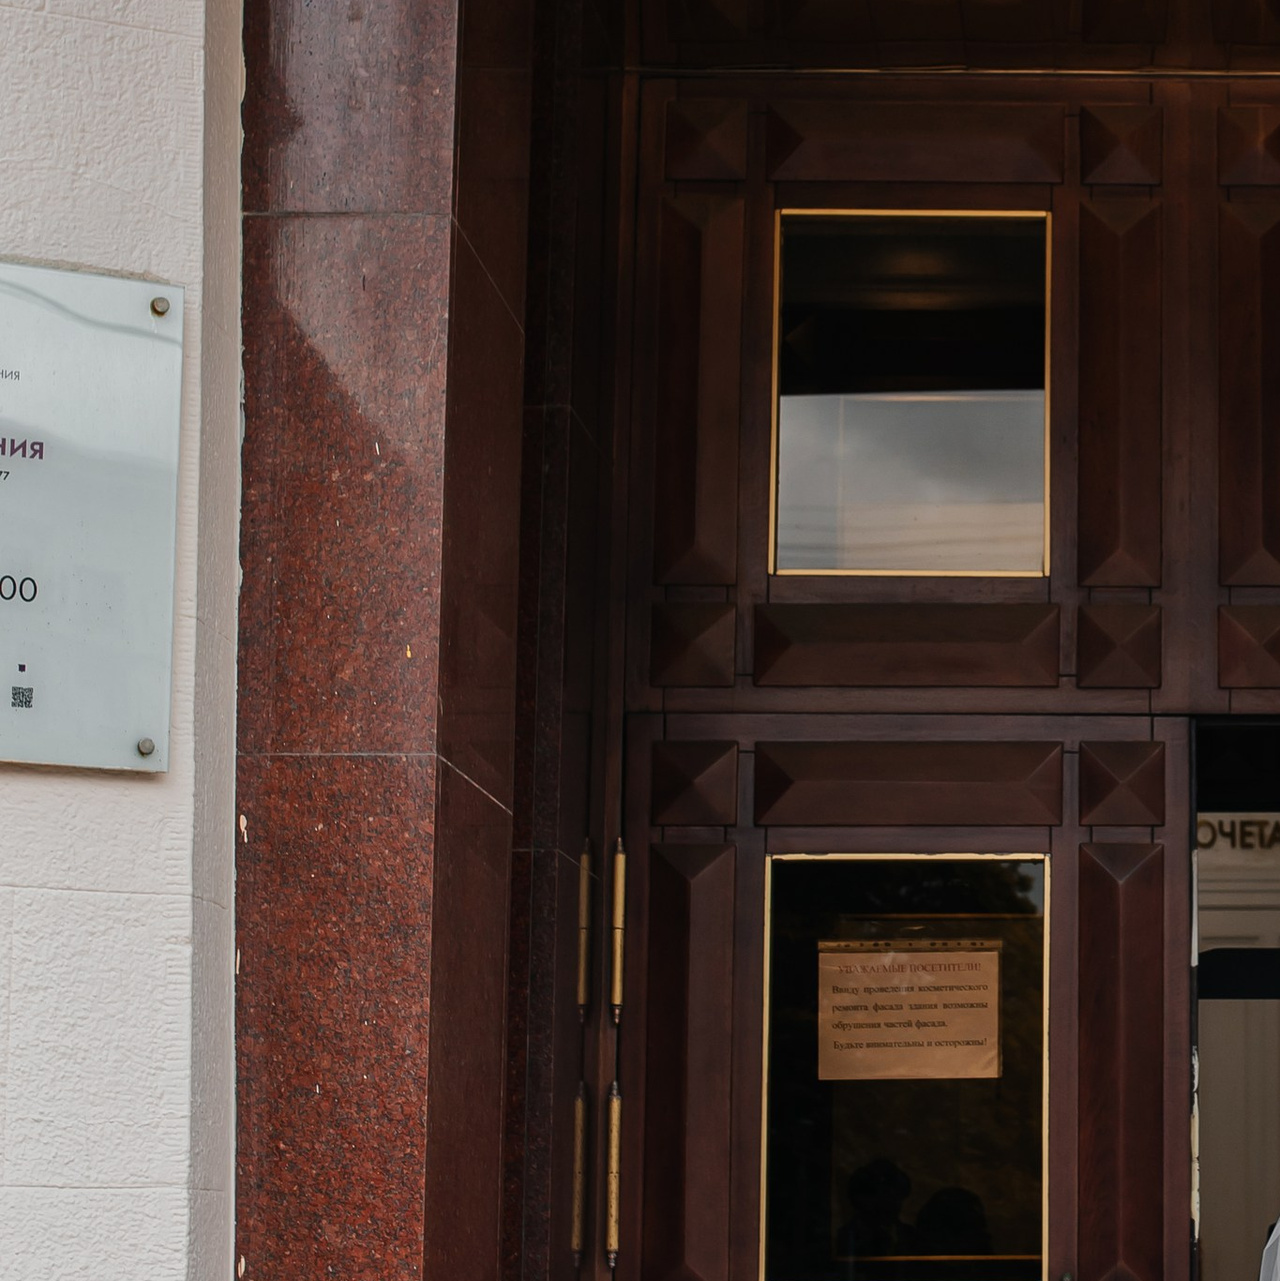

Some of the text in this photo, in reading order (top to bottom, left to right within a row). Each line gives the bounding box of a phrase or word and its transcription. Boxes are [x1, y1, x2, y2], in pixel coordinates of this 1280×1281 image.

[832, 985, 859, 996] Ввиду
[918, 984, 989, 993] косметического
[832, 1004, 869, 1014] ремонта
[872, 1002, 904, 1013] фасада
[832, 1019, 948, 1031] обрушения частей фасада.
[833, 1041, 864, 1051] Будьте
[866, 1041, 925, 1049] внимательны
[935, 1037, 987, 1048] осторожны!
